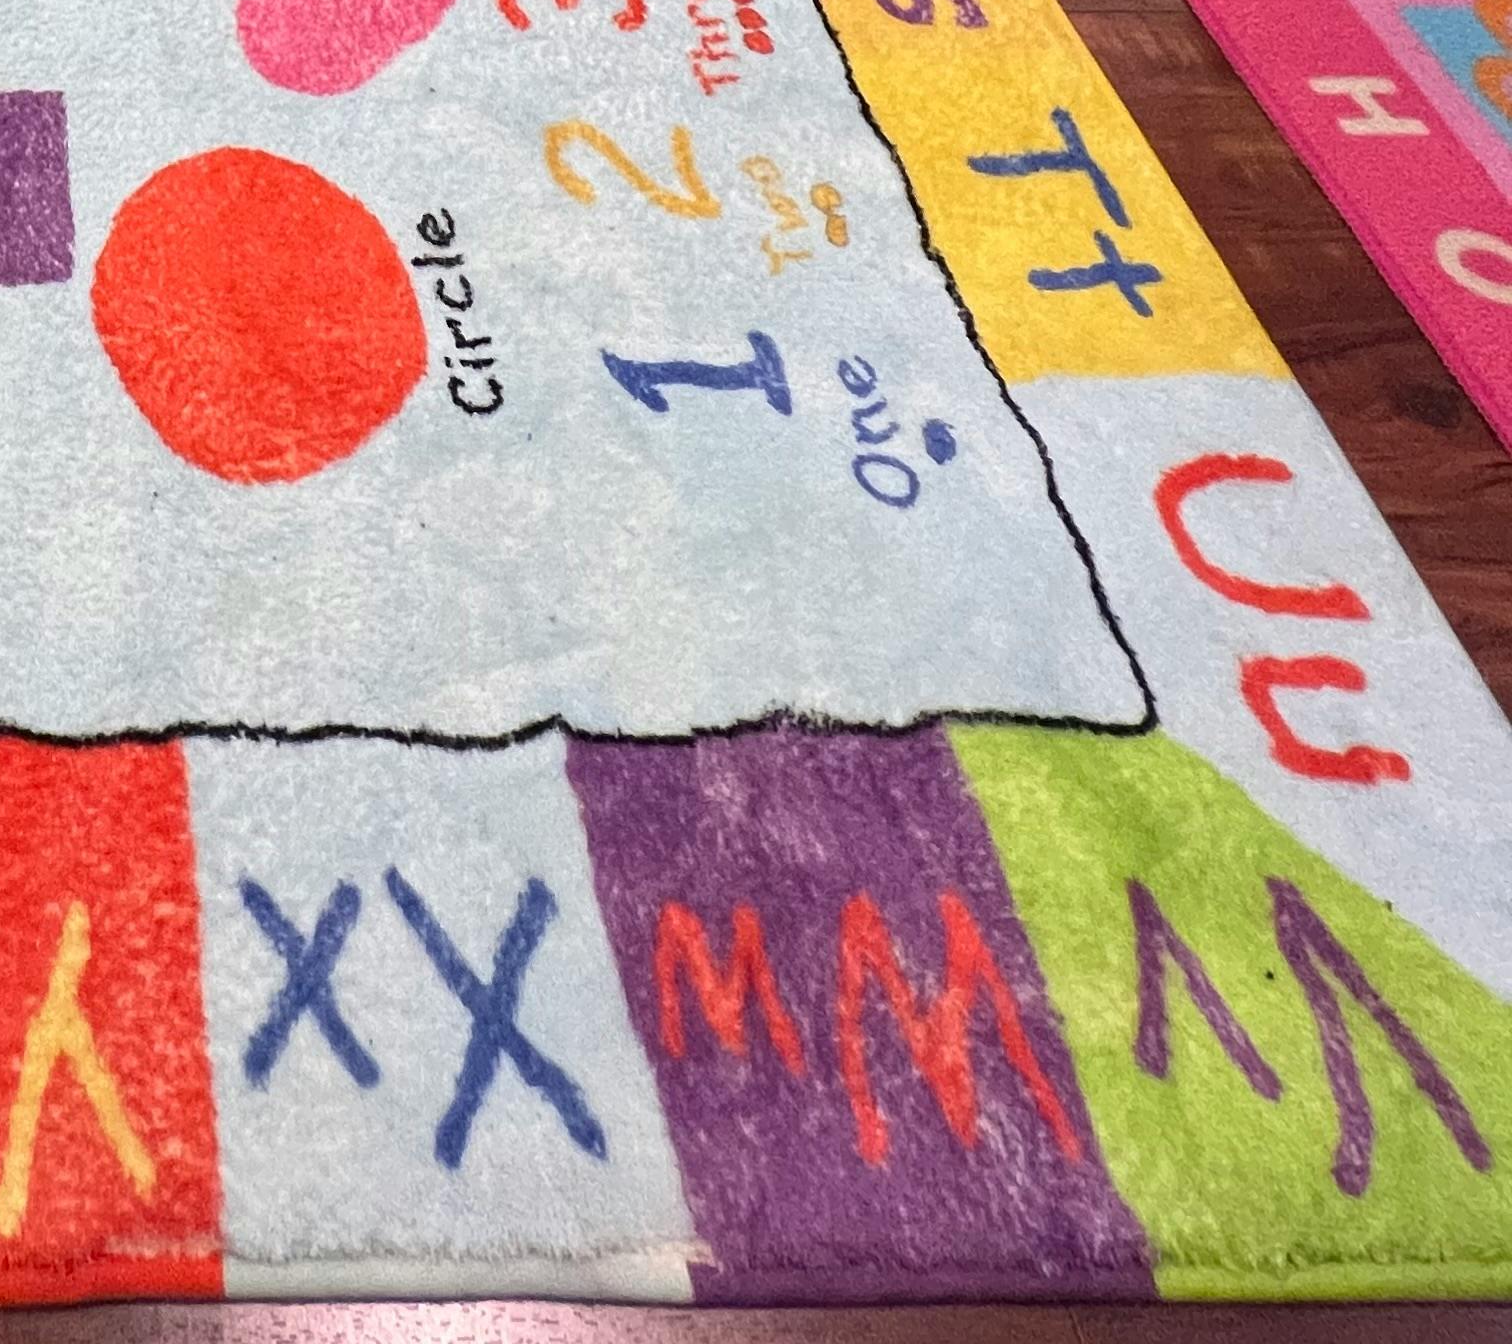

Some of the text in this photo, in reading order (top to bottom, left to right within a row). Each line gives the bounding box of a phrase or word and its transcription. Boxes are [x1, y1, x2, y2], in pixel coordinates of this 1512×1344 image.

[541, 118, 725, 223] 2
[738, 153, 815, 278] Two
[966, 105, 1165, 319] Tt
[410, 204, 506, 420] Circle
[599, 329, 795, 418] 1
[836, 352, 923, 511] One
